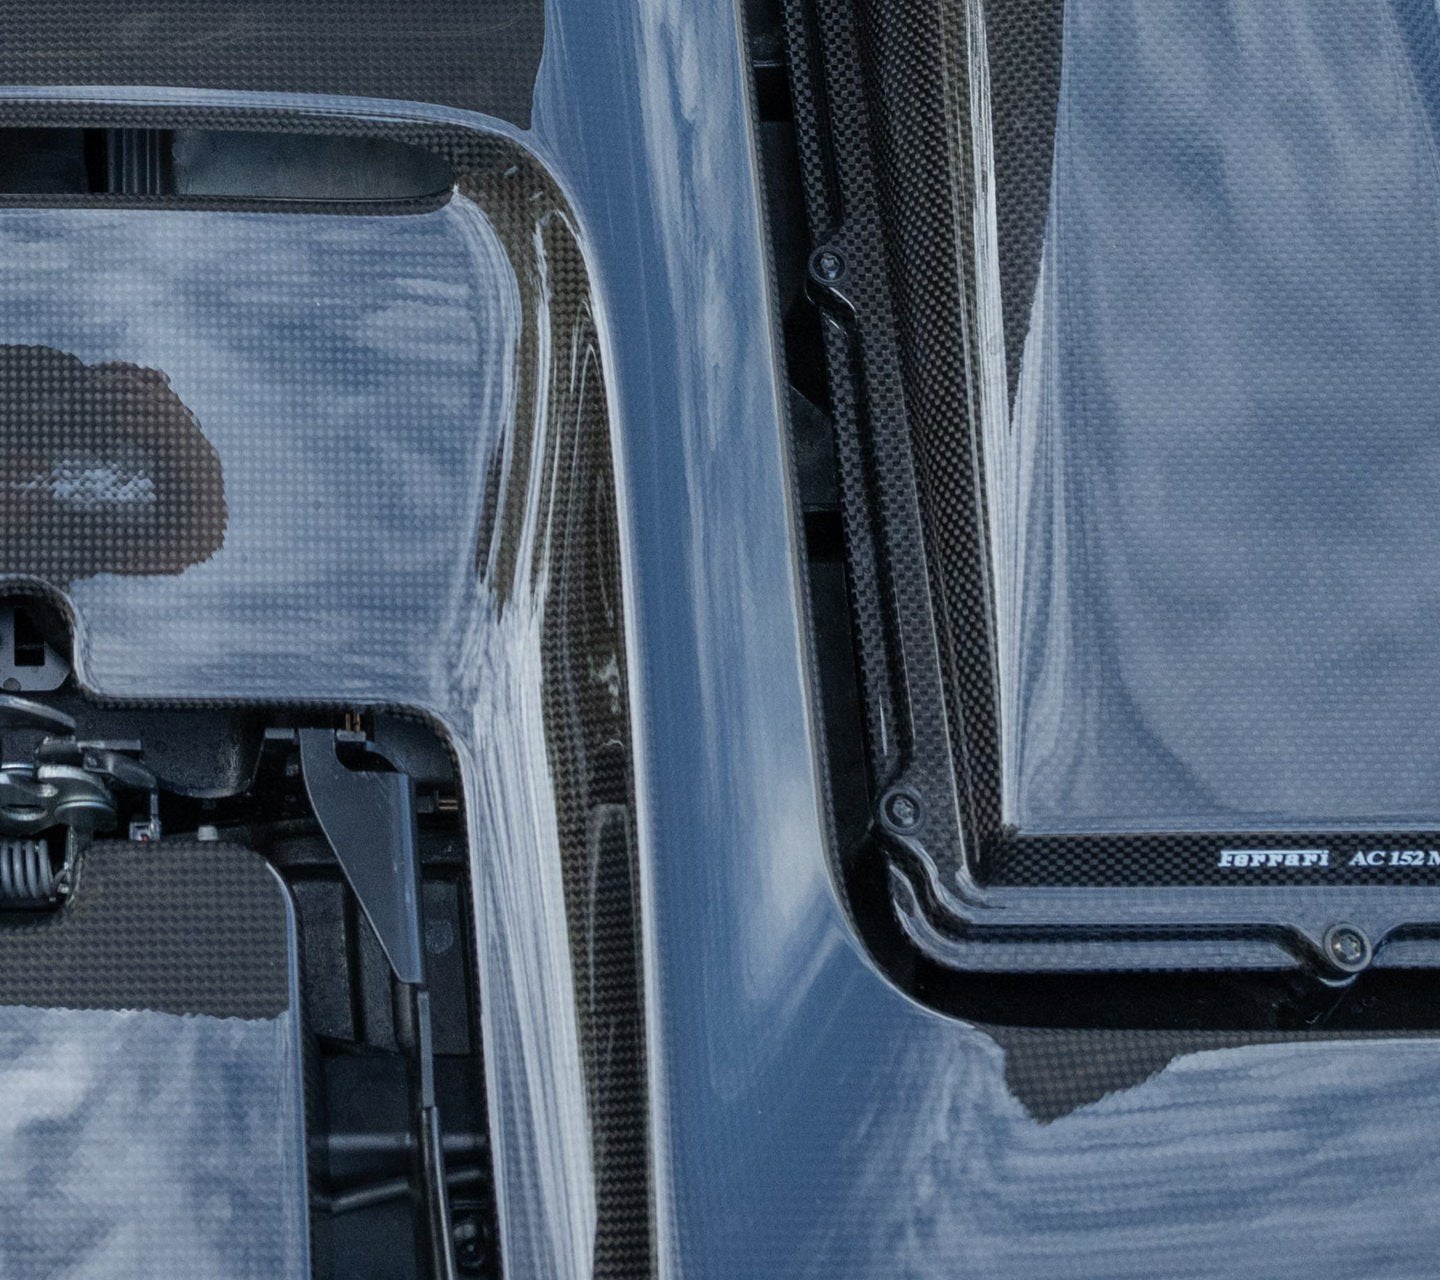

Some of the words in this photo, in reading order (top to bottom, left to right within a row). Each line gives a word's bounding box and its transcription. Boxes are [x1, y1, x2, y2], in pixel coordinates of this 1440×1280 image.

[1217, 850, 1330, 867] Ferrari
[1349, 850, 1386, 866] AC
[1391, 850, 1424, 866] 152
